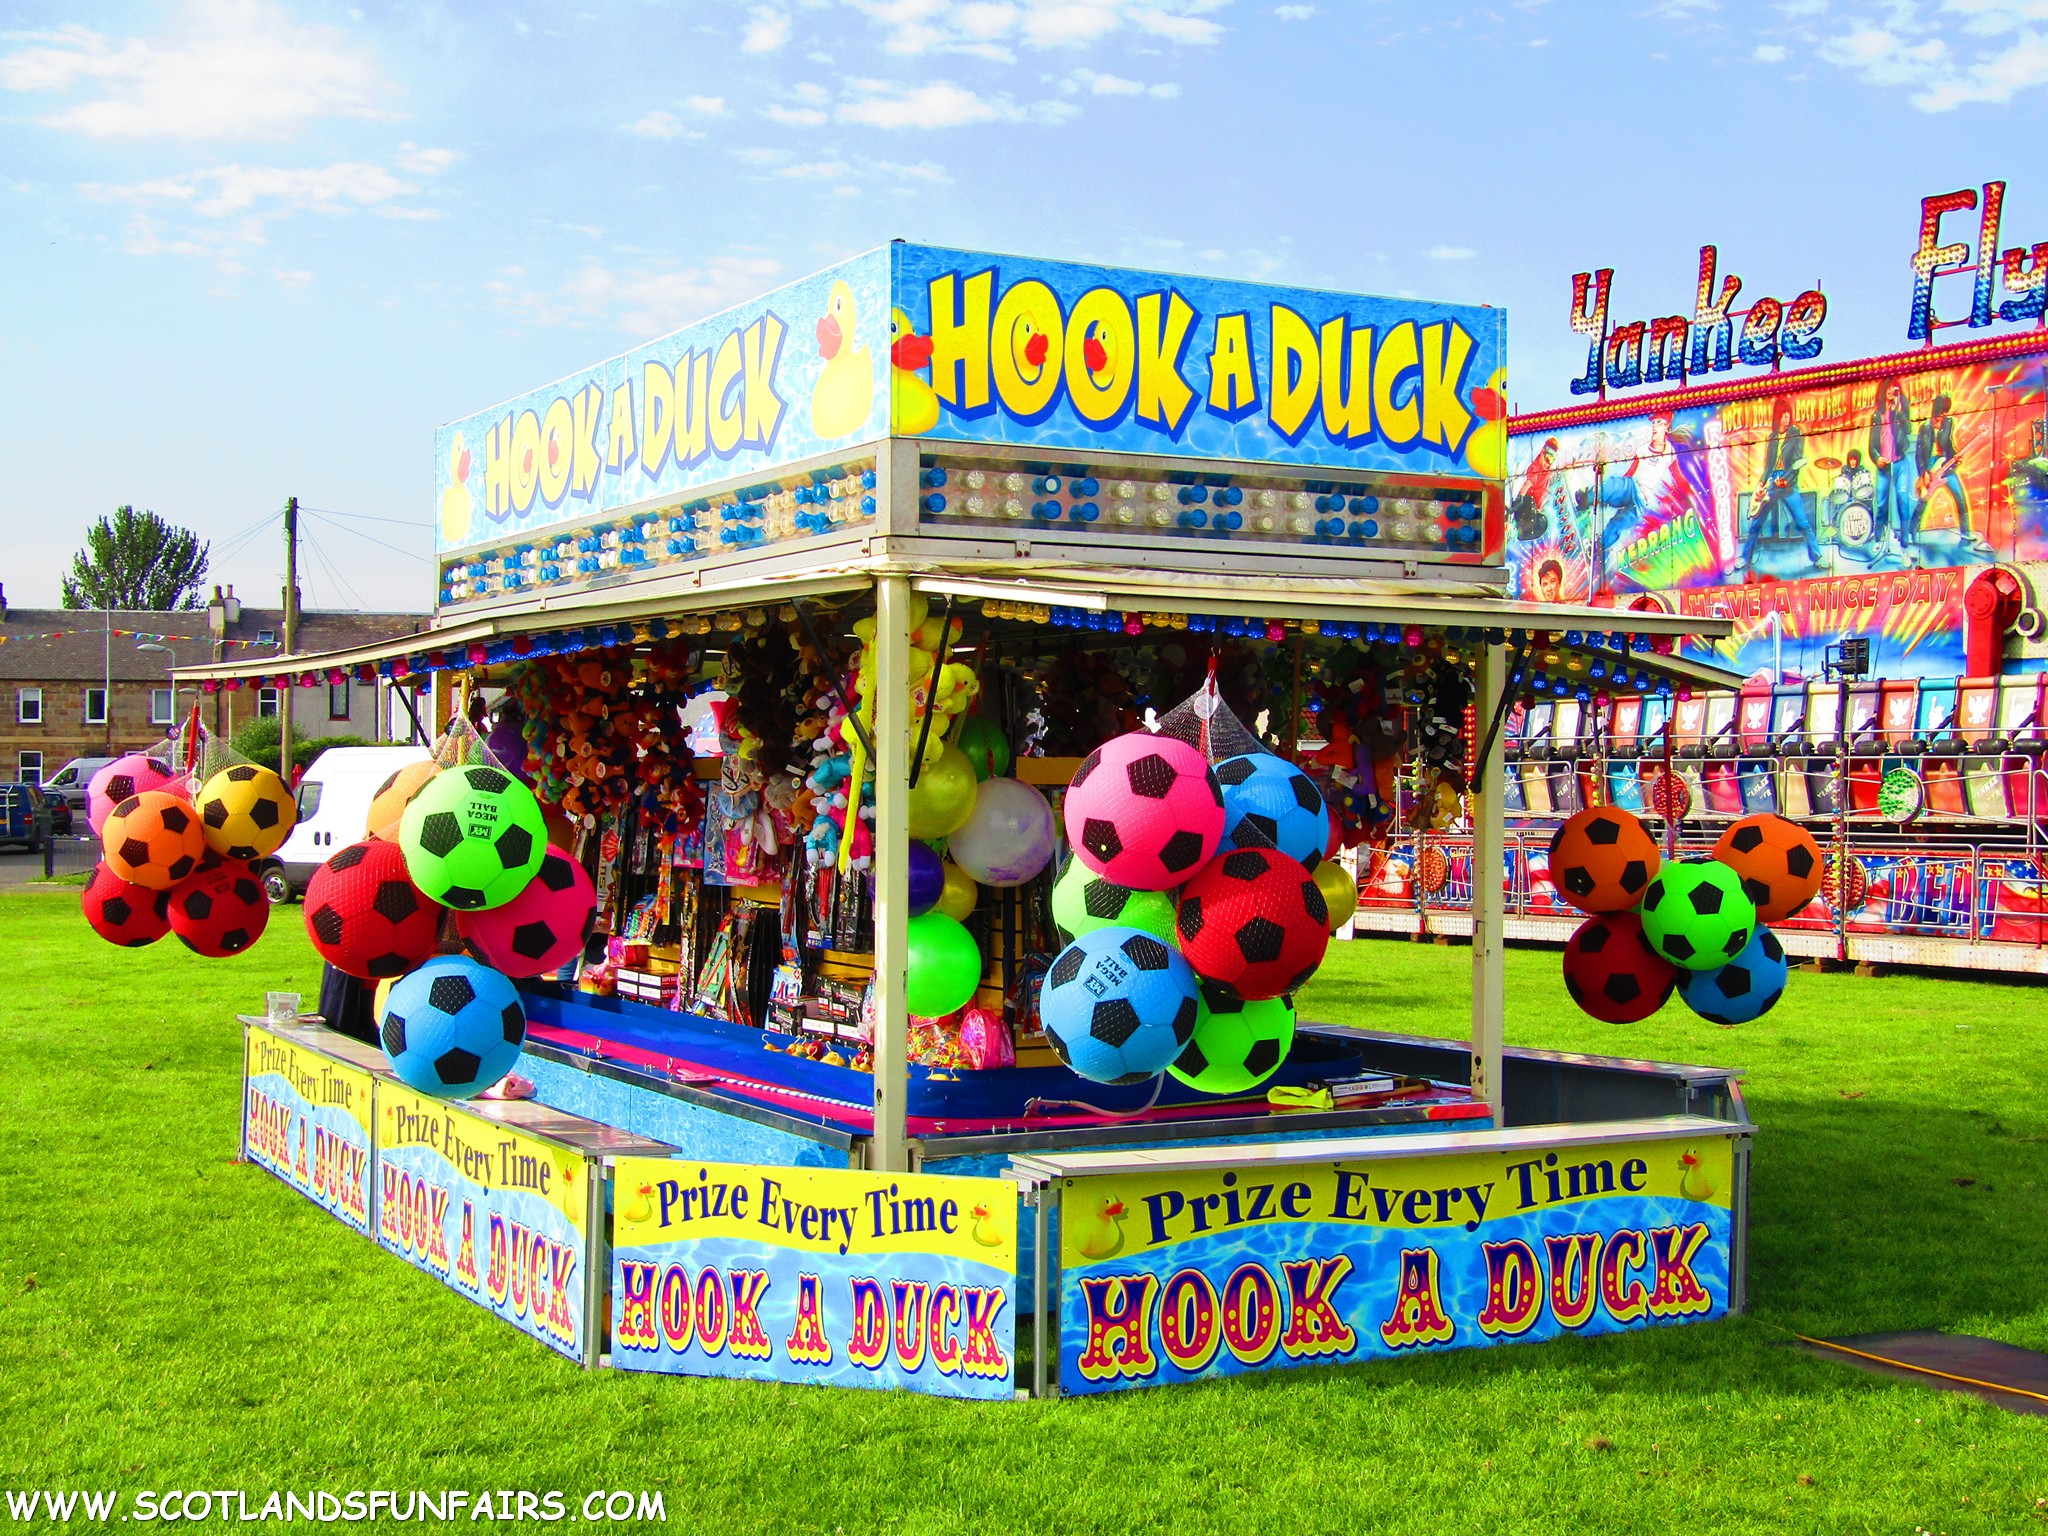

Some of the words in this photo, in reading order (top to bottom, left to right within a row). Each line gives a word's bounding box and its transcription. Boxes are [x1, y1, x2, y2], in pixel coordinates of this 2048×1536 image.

[928, 265, 1201, 442] HOOK
[1205, 310, 1255, 424] A
[1269, 301, 1480, 464] DUCK
[1570, 244, 1829, 396] Yankee
[485, 378, 604, 524] HOOK
[605, 377, 638, 475] A
[641, 309, 789, 483] DUCK
[1554, 485, 1576, 555] AWESOME
[1617, 508, 1697, 570] KERRANG
[1688, 588, 1761, 620] HAVE
[1773, 587, 1793, 616] A
[1808, 577, 1879, 613] NICE
[1891, 572, 1956, 608] DAY
[467, 810, 498, 822] MEGA
[470, 801, 497, 813] BALL
[1889, 855, 2005, 930] BEAT
[1096, 962, 1122, 986] MEGA
[1104, 956, 1128, 978] BALL
[260, 1036, 287, 1076] Prize
[288, 1051, 319, 1111] Every
[321, 1062, 353, 1110] Time
[247, 1086, 292, 1178] HOOK
[295, 1114, 310, 1190] A
[313, 1121, 368, 1229] DUCK
[396, 1099, 439, 1148] Prize
[443, 1113, 495, 1196] Every
[498, 1138, 551, 1195] Time
[656, 1167, 749, 1229] Prize
[757, 1177, 859, 1256] Every
[865, 1183, 959, 1238] Time
[1141, 1171, 1313, 1246] Prize
[1329, 1168, 1496, 1233] Every
[1505, 1151, 1648, 1210] Time
[380, 1158, 449, 1278] HOOK
[456, 1196, 479, 1293] A
[486, 1208, 577, 1349] DUCK
[616, 1258, 773, 1362] HOOK
[786, 1272, 833, 1367] A
[847, 1275, 1009, 1384] DUCK
[1076, 1252, 1356, 1383] HOOK
[1379, 1245, 1455, 1352] A
[1476, 1221, 1715, 1338] DUCK
